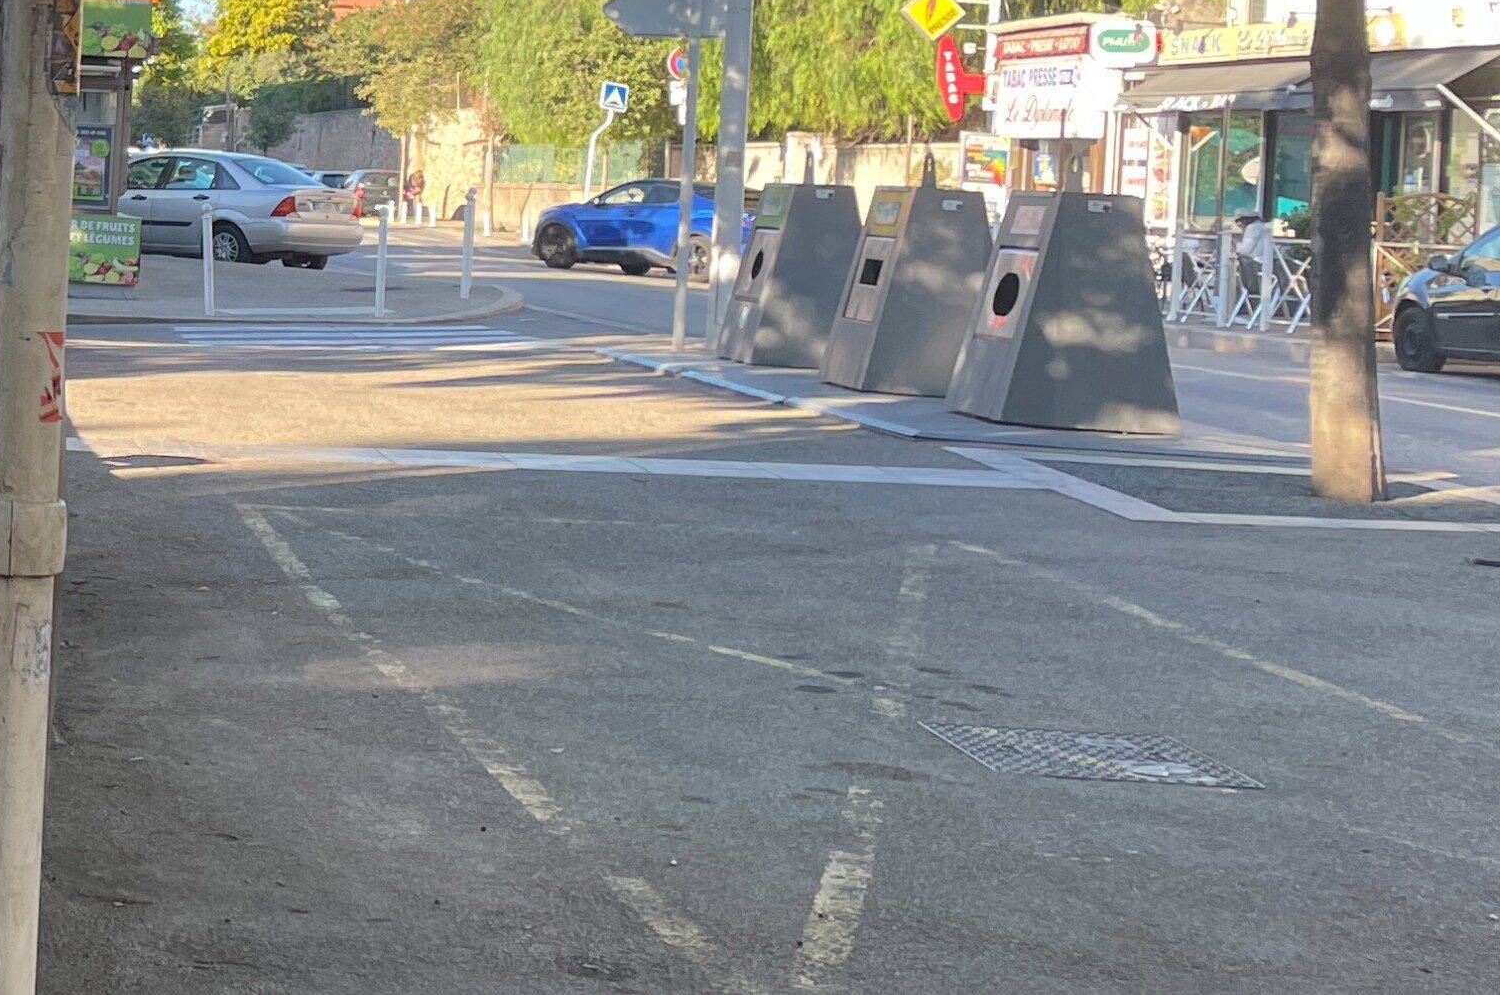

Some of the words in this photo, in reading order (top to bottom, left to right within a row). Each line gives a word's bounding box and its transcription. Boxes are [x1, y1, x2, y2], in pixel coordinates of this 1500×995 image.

[927, 8, 959, 34] PRESSE
[943, 50, 959, 104] TABAC
[1029, 66, 1058, 87] PRESSE
[80, 220, 95, 231] DE
[96, 221, 136, 233] FRUITS
